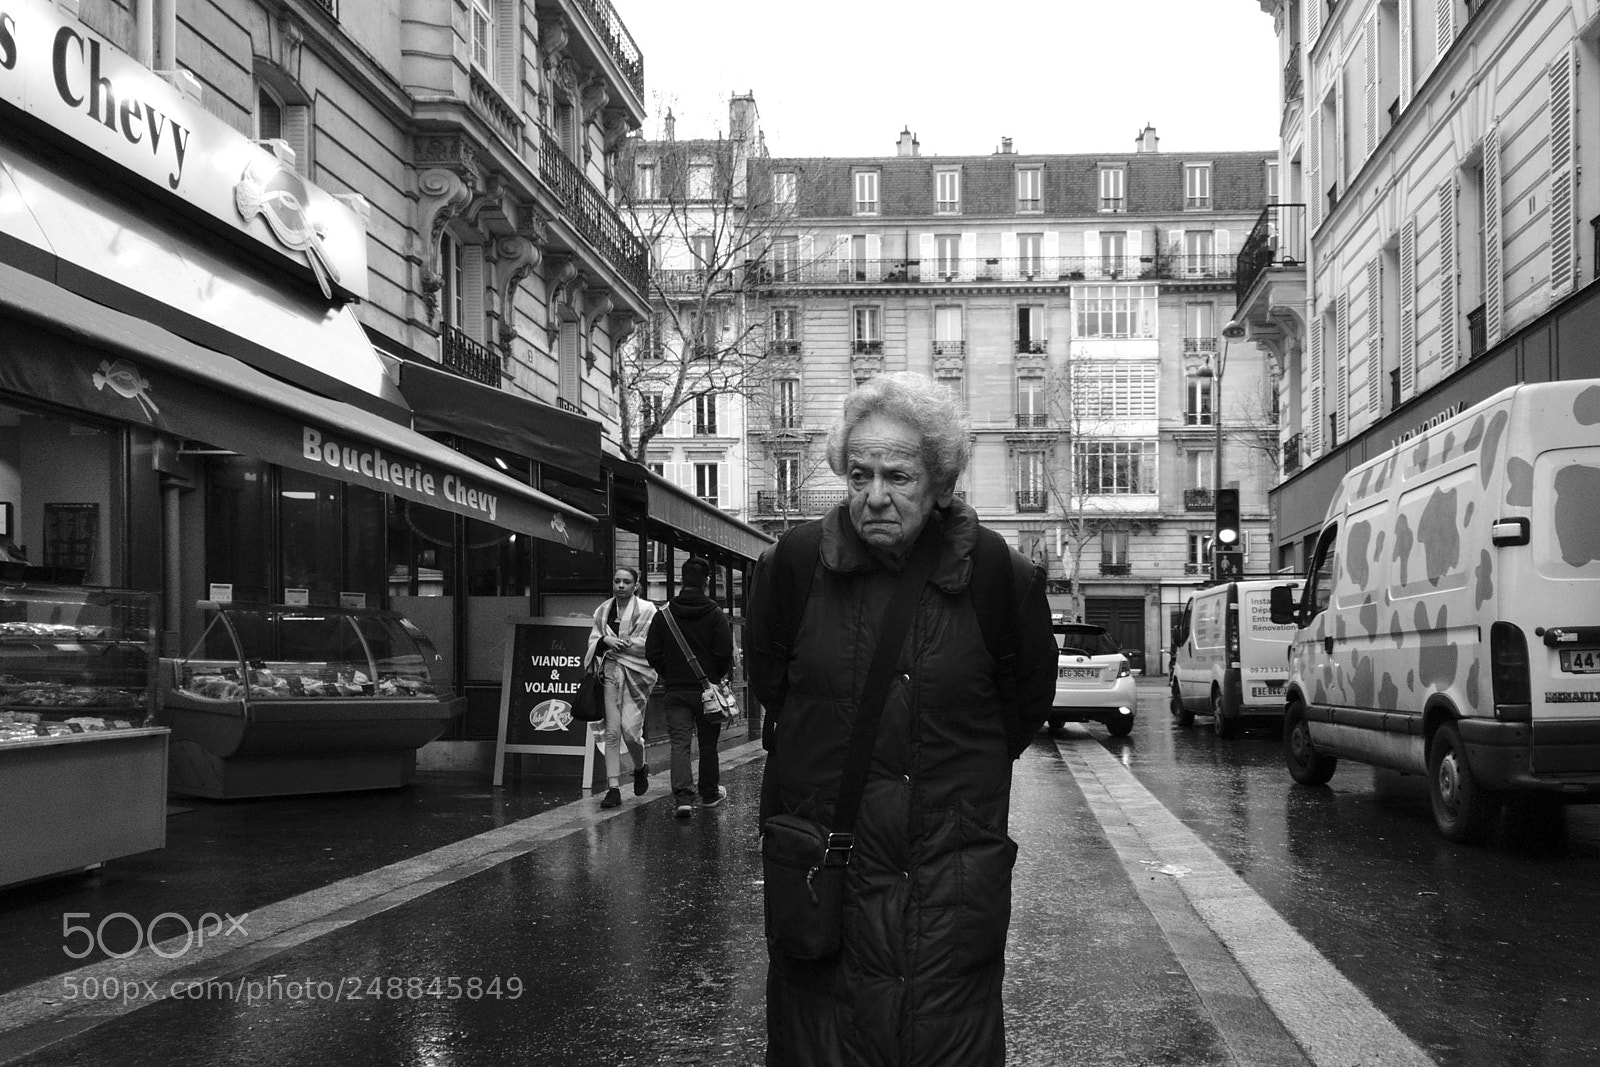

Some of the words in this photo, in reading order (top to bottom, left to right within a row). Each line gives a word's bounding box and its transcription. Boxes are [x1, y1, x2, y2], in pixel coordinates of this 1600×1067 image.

[52, 25, 190, 190] Chevy
[303, 425, 435, 496] Boucherie
[443, 474, 497, 520] Chevy
[531, 655, 581, 667] VIANDES
[550, 669, 560, 680] &
